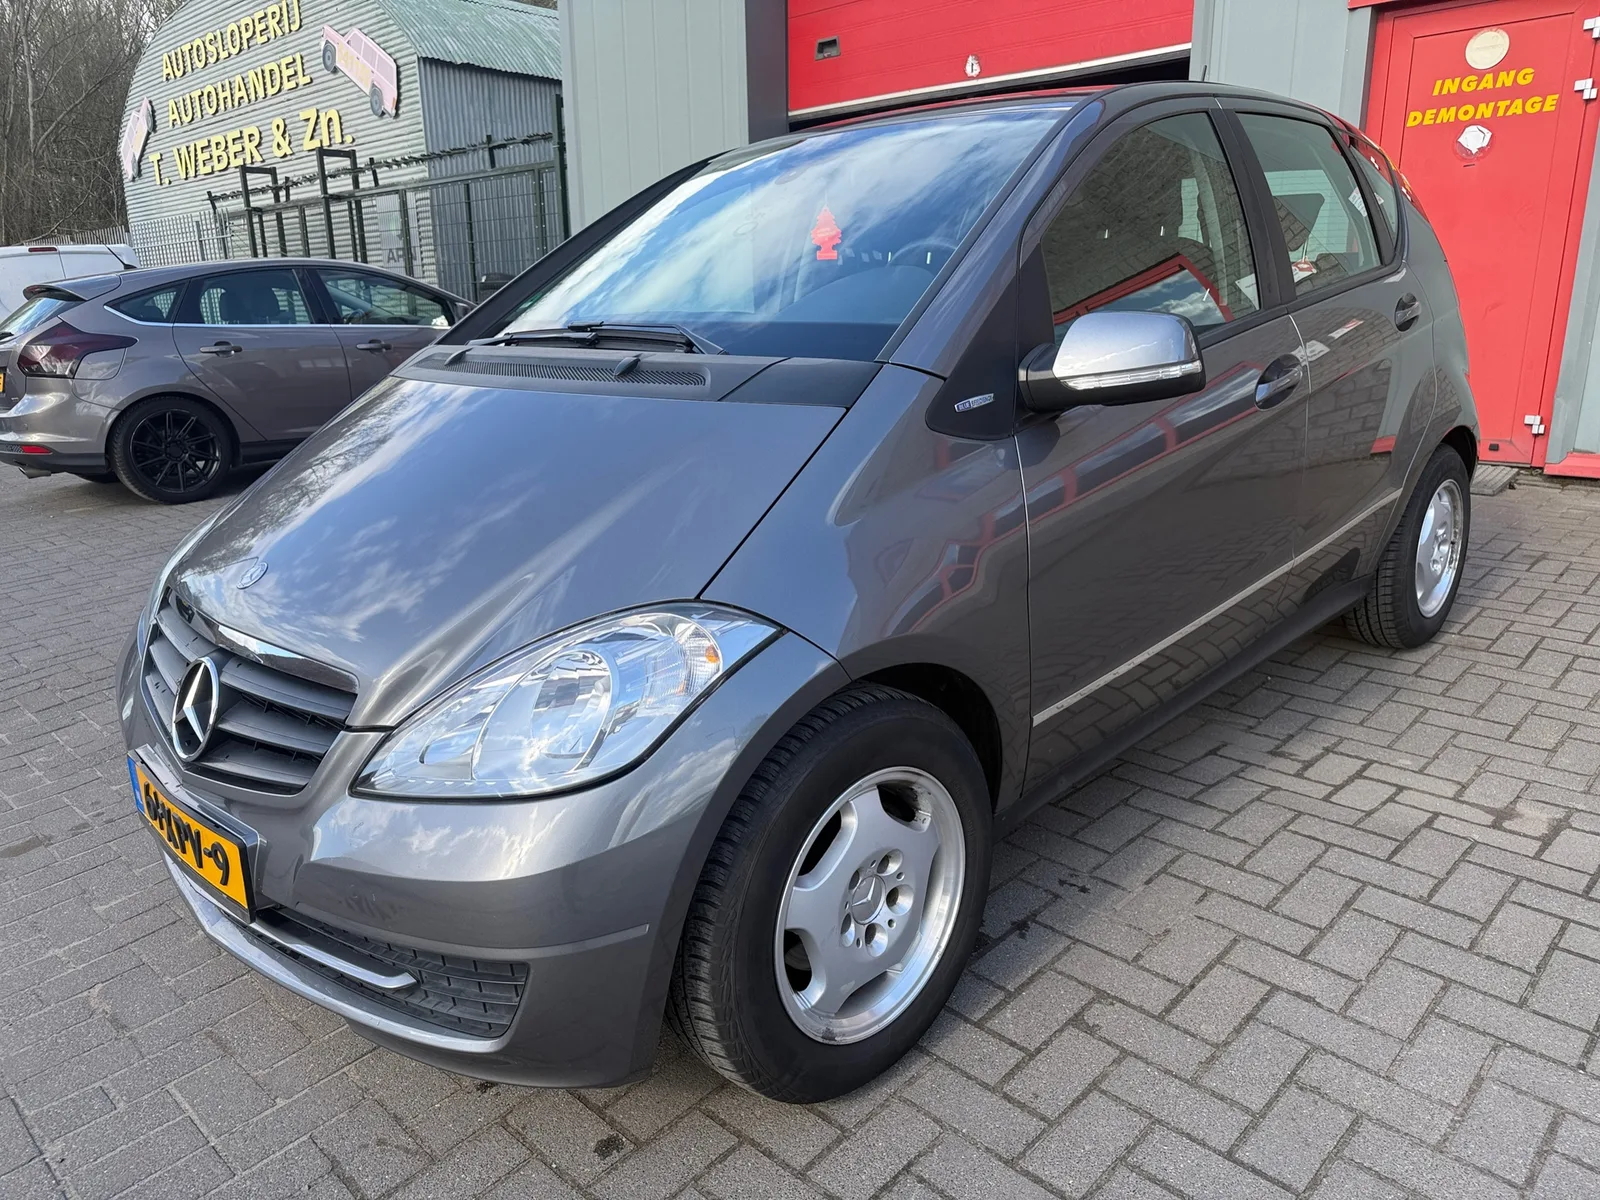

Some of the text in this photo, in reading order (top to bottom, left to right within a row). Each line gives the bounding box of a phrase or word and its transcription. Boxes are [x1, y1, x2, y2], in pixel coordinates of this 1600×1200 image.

[162, 0, 300, 82] AUTOSLOPERIJ
[168, 52, 312, 127] AUTOHANDEL
[1406, 94, 1560, 128] DEMONTAGE
[1432, 67, 1535, 96] INGANG
[149, 107, 355, 185] T. WEBER & Zn.
